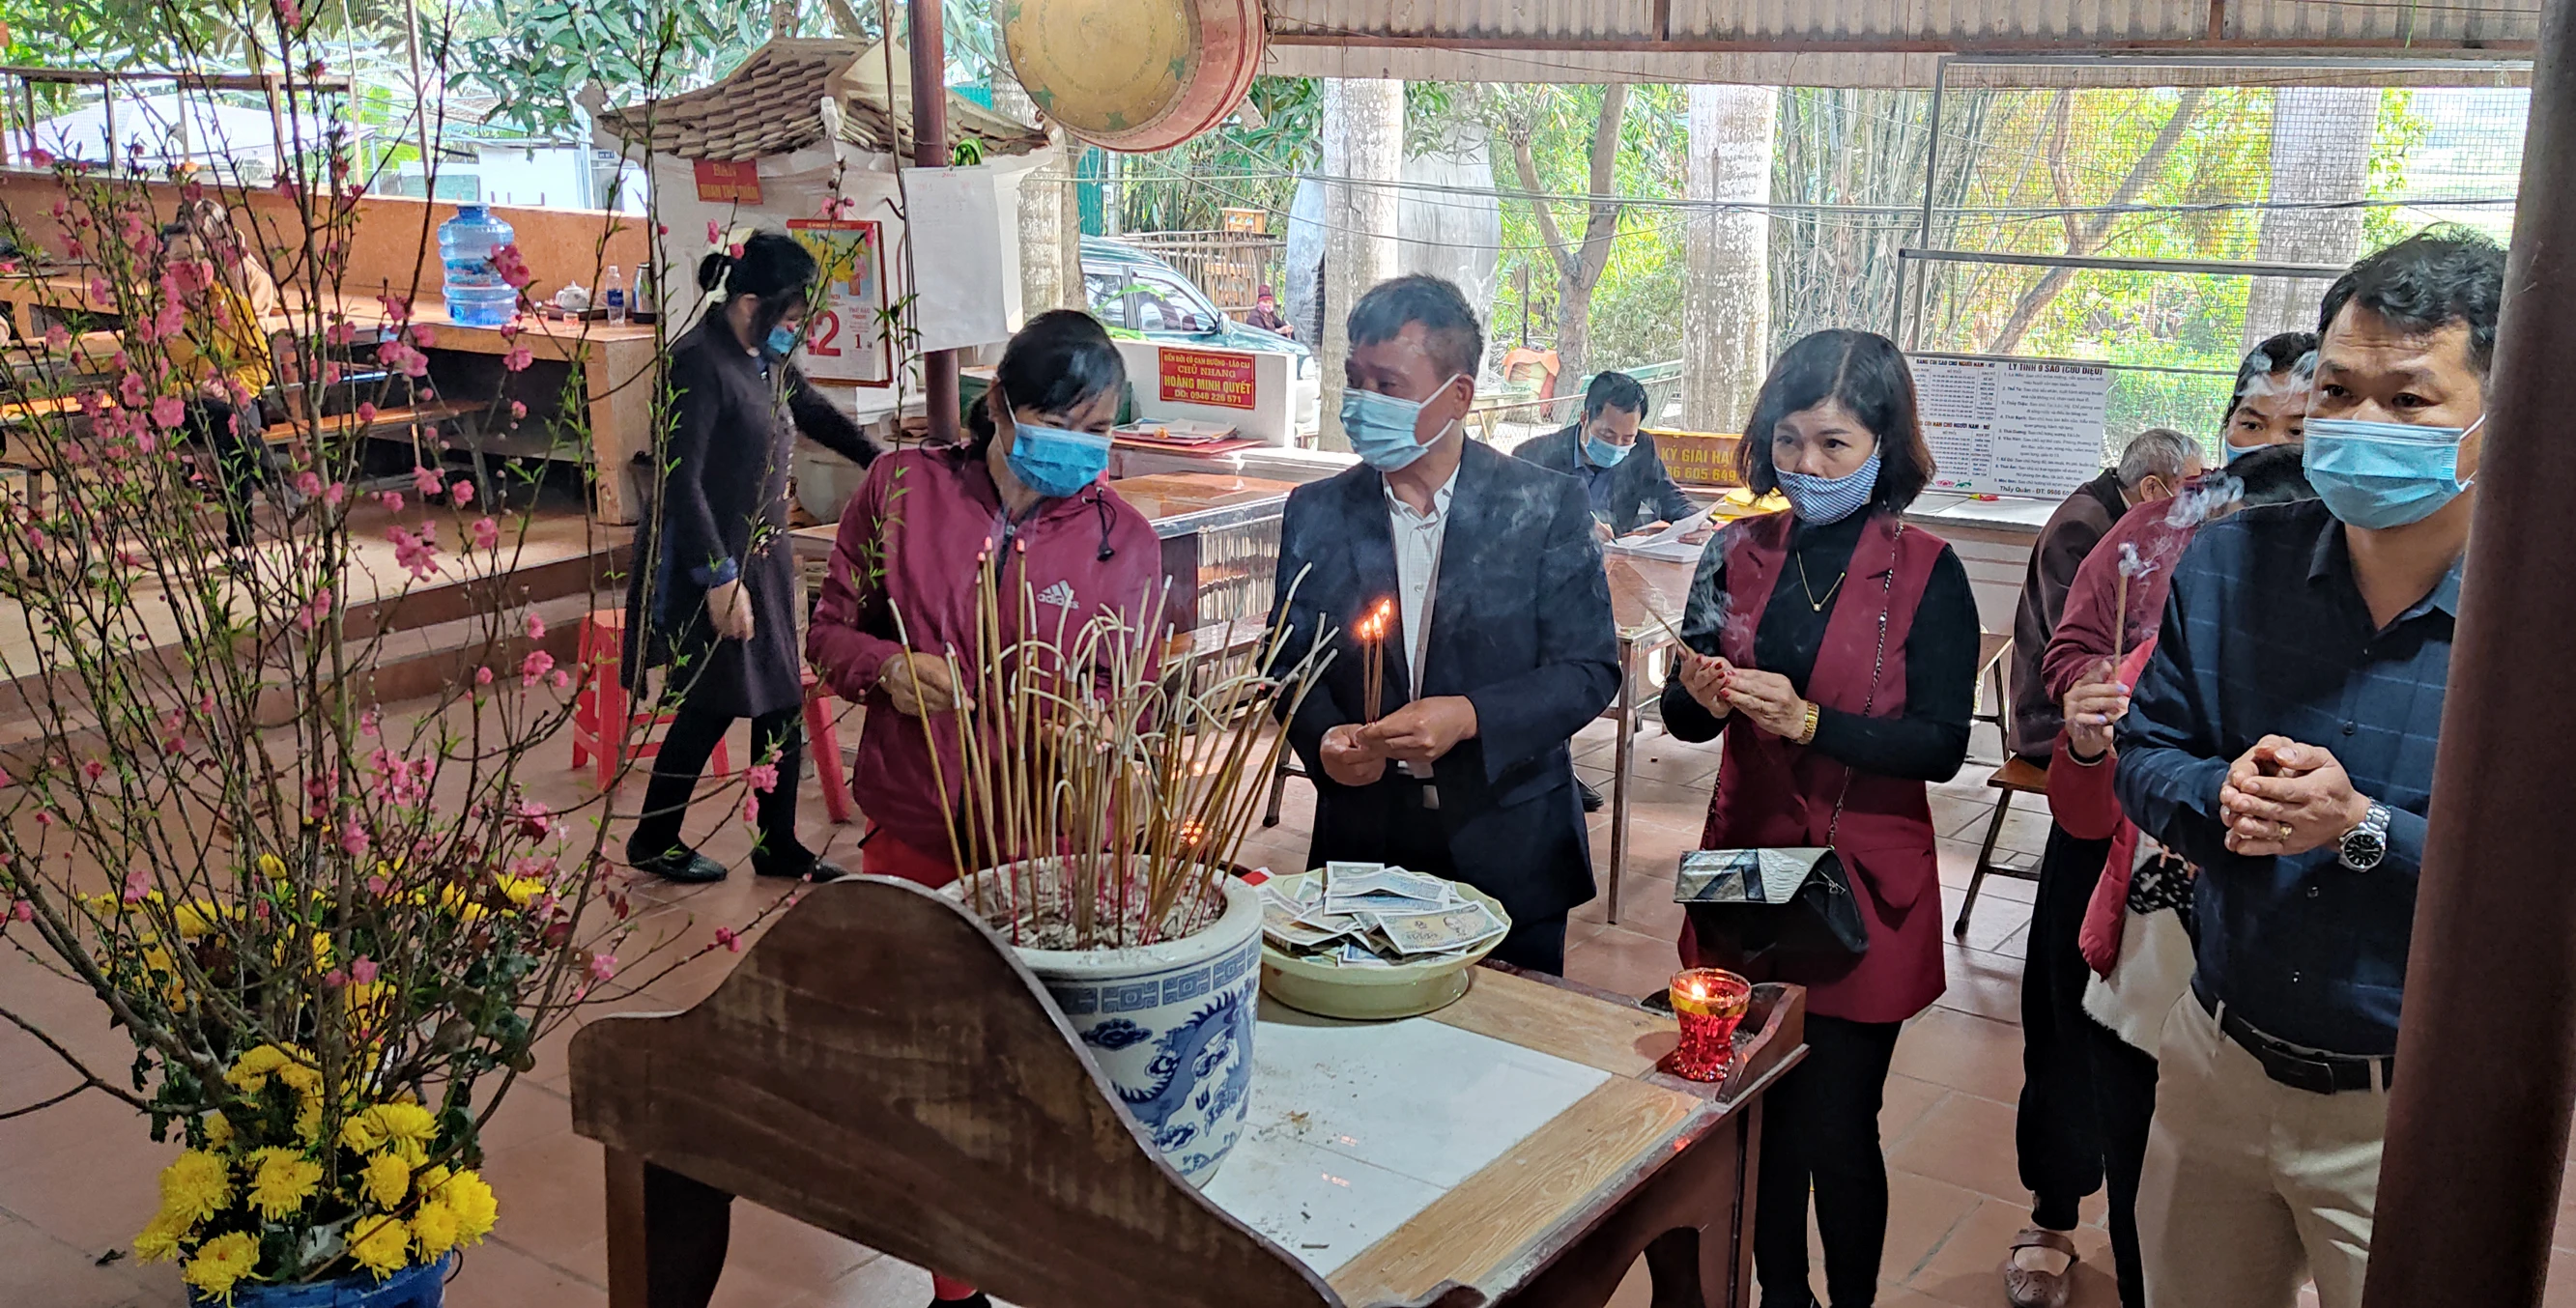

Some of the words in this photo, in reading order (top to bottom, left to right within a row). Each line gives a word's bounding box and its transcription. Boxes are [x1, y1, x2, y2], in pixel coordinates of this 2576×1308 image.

[1200, 368, 1236, 378] NHANG
[1164, 374, 1194, 389] HOÀNG
[1196, 378, 1220, 391] MINH
[1223, 379, 1252, 394] QUYẾT
[1682, 445, 1708, 463] GIẢI
[1684, 467, 1708, 480] 605
[1712, 469, 1737, 482] 649
[1037, 594, 1079, 610] adids
